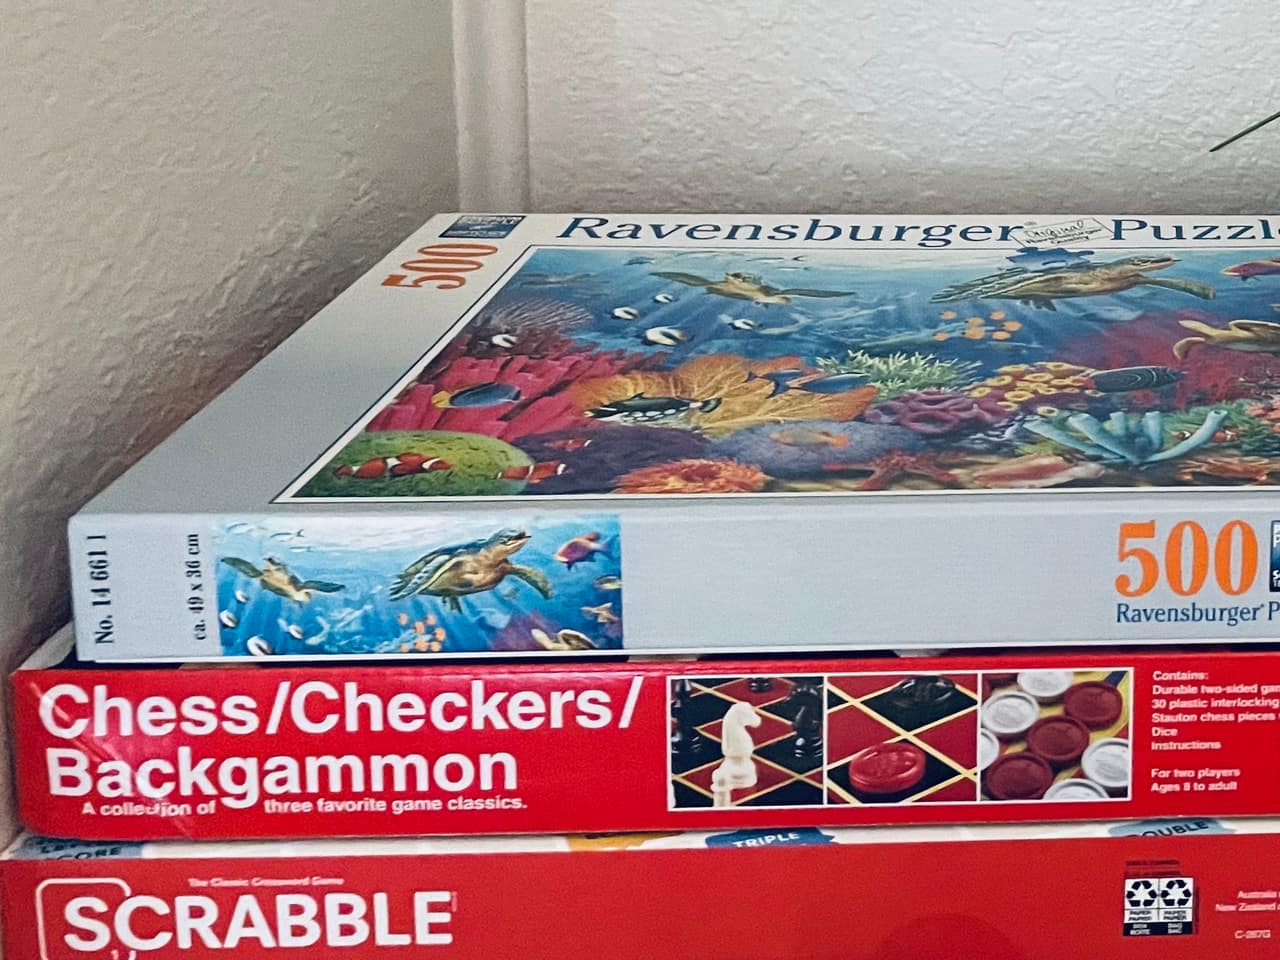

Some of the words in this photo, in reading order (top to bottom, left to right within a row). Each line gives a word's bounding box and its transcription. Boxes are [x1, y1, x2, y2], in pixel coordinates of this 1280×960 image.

[556, 217, 1025, 248] Ravensburger
[380, 243, 498, 290] 500
[187, 534, 200, 555] cm
[87, 550, 109, 580] 661
[1115, 519, 1258, 597] 500
[1116, 602, 1260, 626] Ravensburger
[94, 615, 114, 644] No.
[194, 620, 206, 640] ca.
[1153, 671, 1209, 682] Contains:
[1152, 684, 1198, 695] Durable
[1201, 683, 1258, 694] two-sided
[39, 676, 639, 736] Chess/Checkers/
[1152, 698, 1167, 709] 30
[1169, 697, 1208, 710] plastic
[1211, 696, 1280, 709] interlocking
[1200, 711, 1235, 722] chess
[1238, 711, 1276, 723] pieces
[1152, 726, 1178, 737] Dice
[46, 744, 517, 809] Backgammon
[1151, 769, 1171, 779] For
[1174, 768, 1195, 778] two
[1198, 767, 1241, 780] players
[1151, 782, 1180, 794] Ages
[1184, 781, 1190, 791] 8
[1193, 781, 1205, 791] to
[1208, 781, 1238, 791] adult
[82, 802, 96, 814] A
[198, 800, 216, 814] of
[264, 798, 312, 812] three
[317, 797, 386, 812] favorite
[391, 798, 441, 814] game
[447, 795, 528, 811] classics.
[1127, 820, 1209, 837] OUBLE
[64, 890, 454, 951] SCRABBLE
